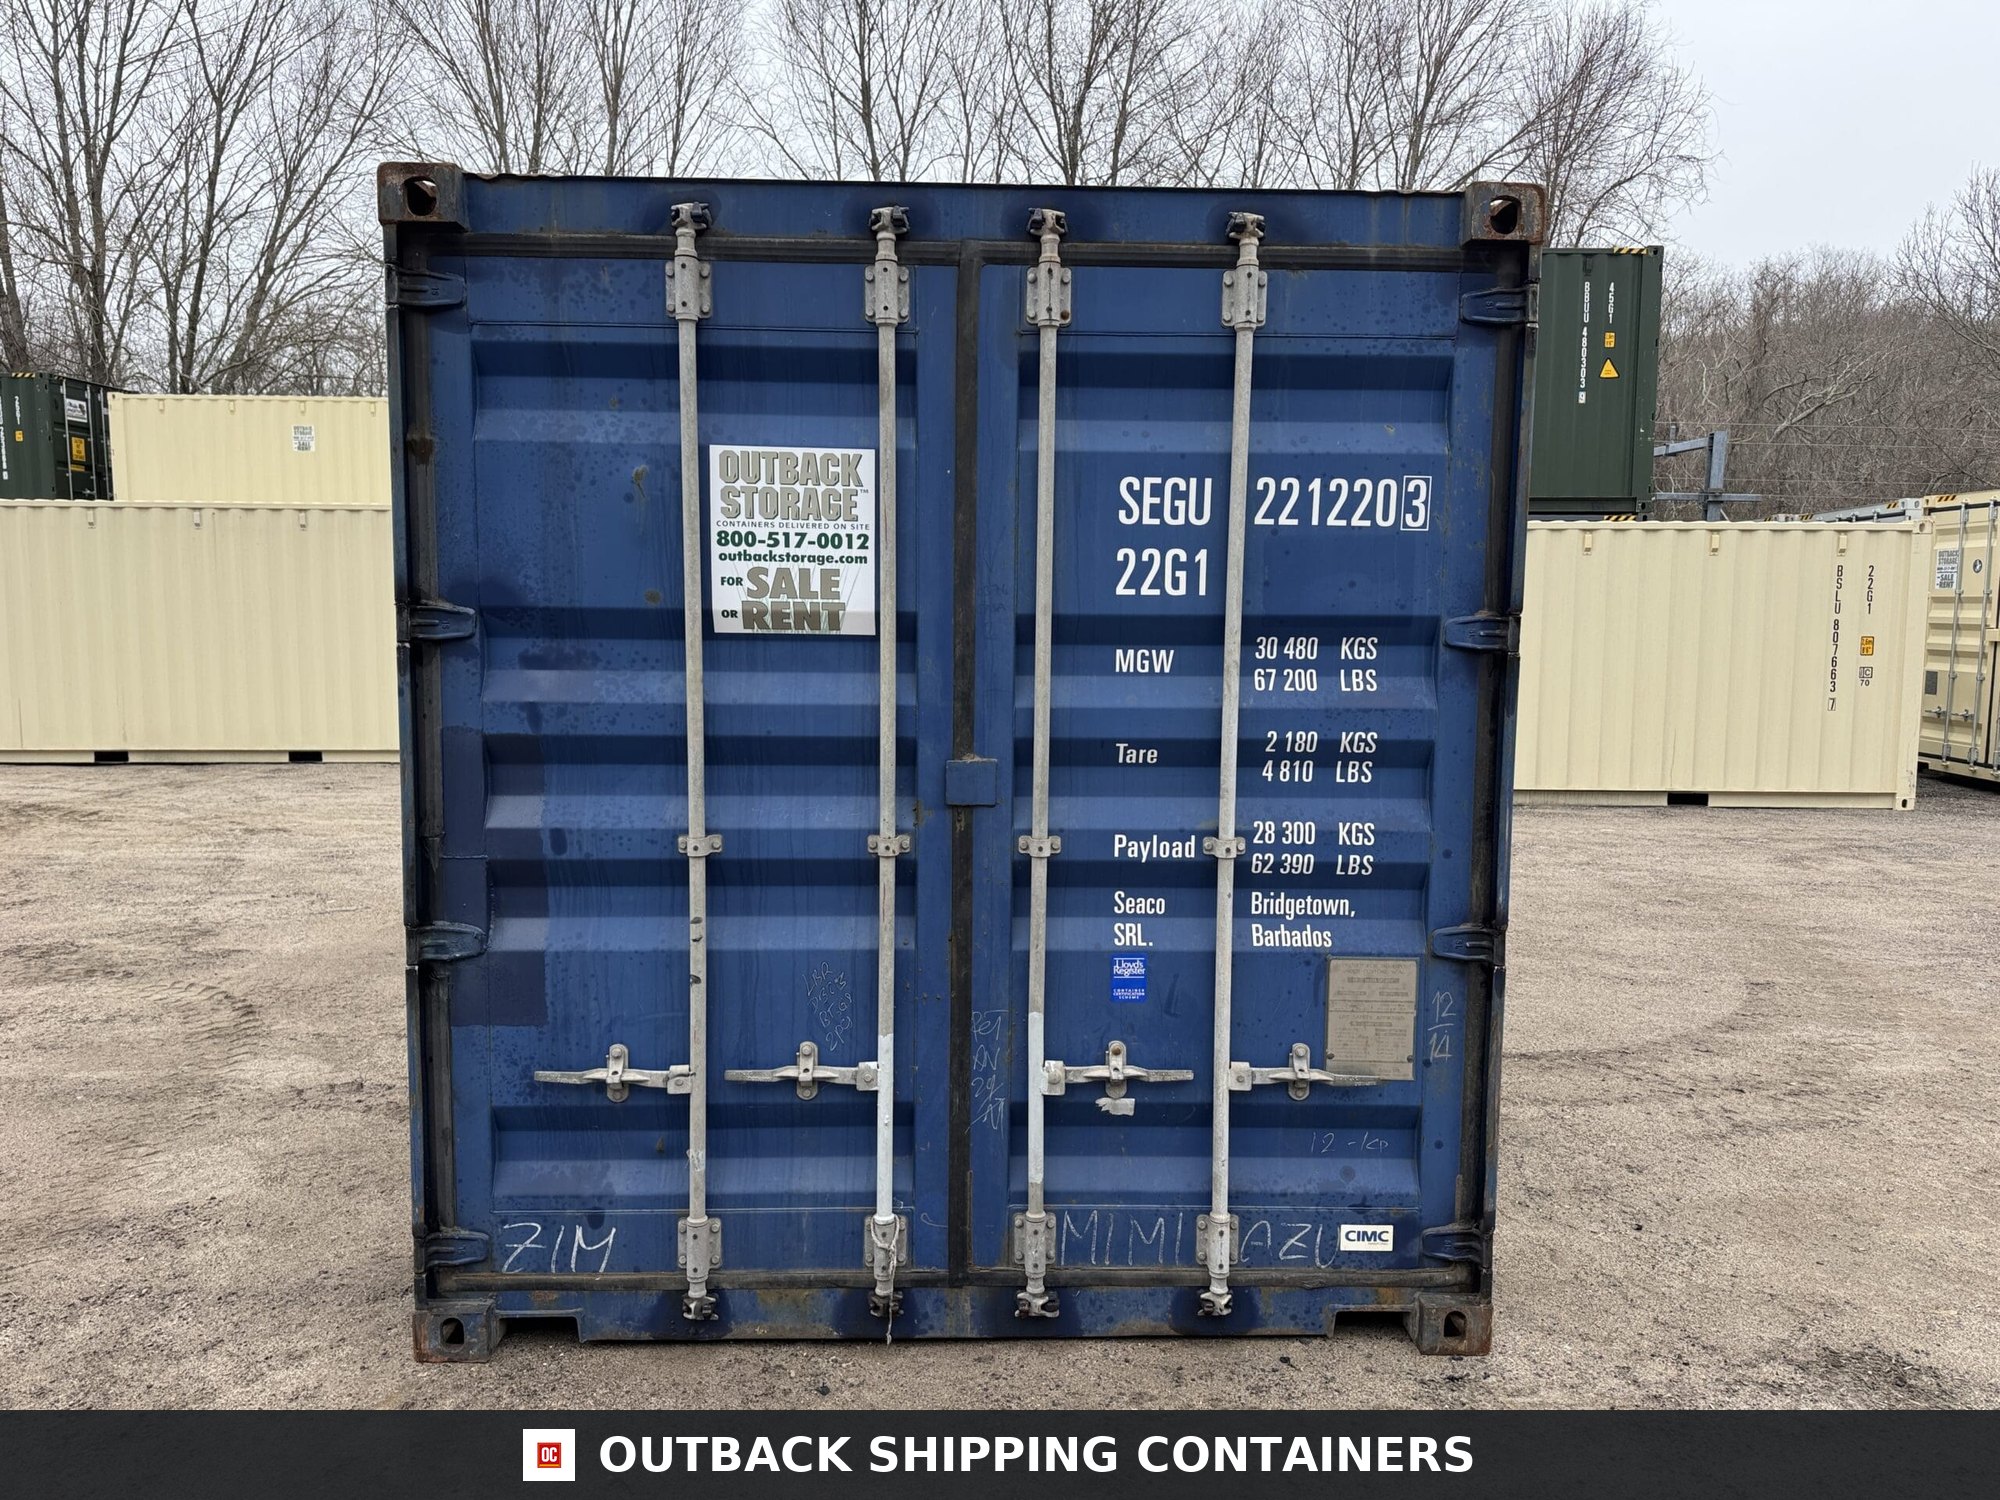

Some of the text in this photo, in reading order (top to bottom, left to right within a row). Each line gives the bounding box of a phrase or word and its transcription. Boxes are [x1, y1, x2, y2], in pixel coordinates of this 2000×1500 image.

[1579, 326, 1588, 389] 480303
[719, 450, 864, 488] OUTBACK
[720, 485, 859, 522] STORAGE
[1118, 476, 1213, 526] SEGU
[716, 520, 775, 529] CONTAINERS
[779, 521, 830, 530] DELIVERED
[851, 523, 870, 531] SITE
[716, 530, 870, 550] 800-517-0012
[719, 550, 868, 565] outbackstorage.com
[1115, 548, 1208, 596] 22G1
[720, 566, 841, 600] FOR SALE
[1866, 564, 1875, 615] 22G1
[721, 600, 846, 631] OR RENT
[1828, 564, 1843, 711] BSLU 807663 7
[1115, 637, 1378, 673] MGW 30 480 KGS
[1254, 669, 1378, 692] 67 200 LBS
[1115, 731, 1378, 764] Tare 2 180 KGS
[1262, 760, 1373, 783] 4 810 LBS
[1114, 821, 1376, 863] Payload 28 300 KGS
[1251, 853, 1374, 876] 62 390 LBS
[1114, 890, 1356, 920] Seaco Bridgetown,
[1114, 923, 1333, 948] SRL. Barbados
[1113, 965, 1146, 977] Register
[503, 1221, 617, 1275] ZIM
[1344, 1230, 1390, 1242] CIMC
